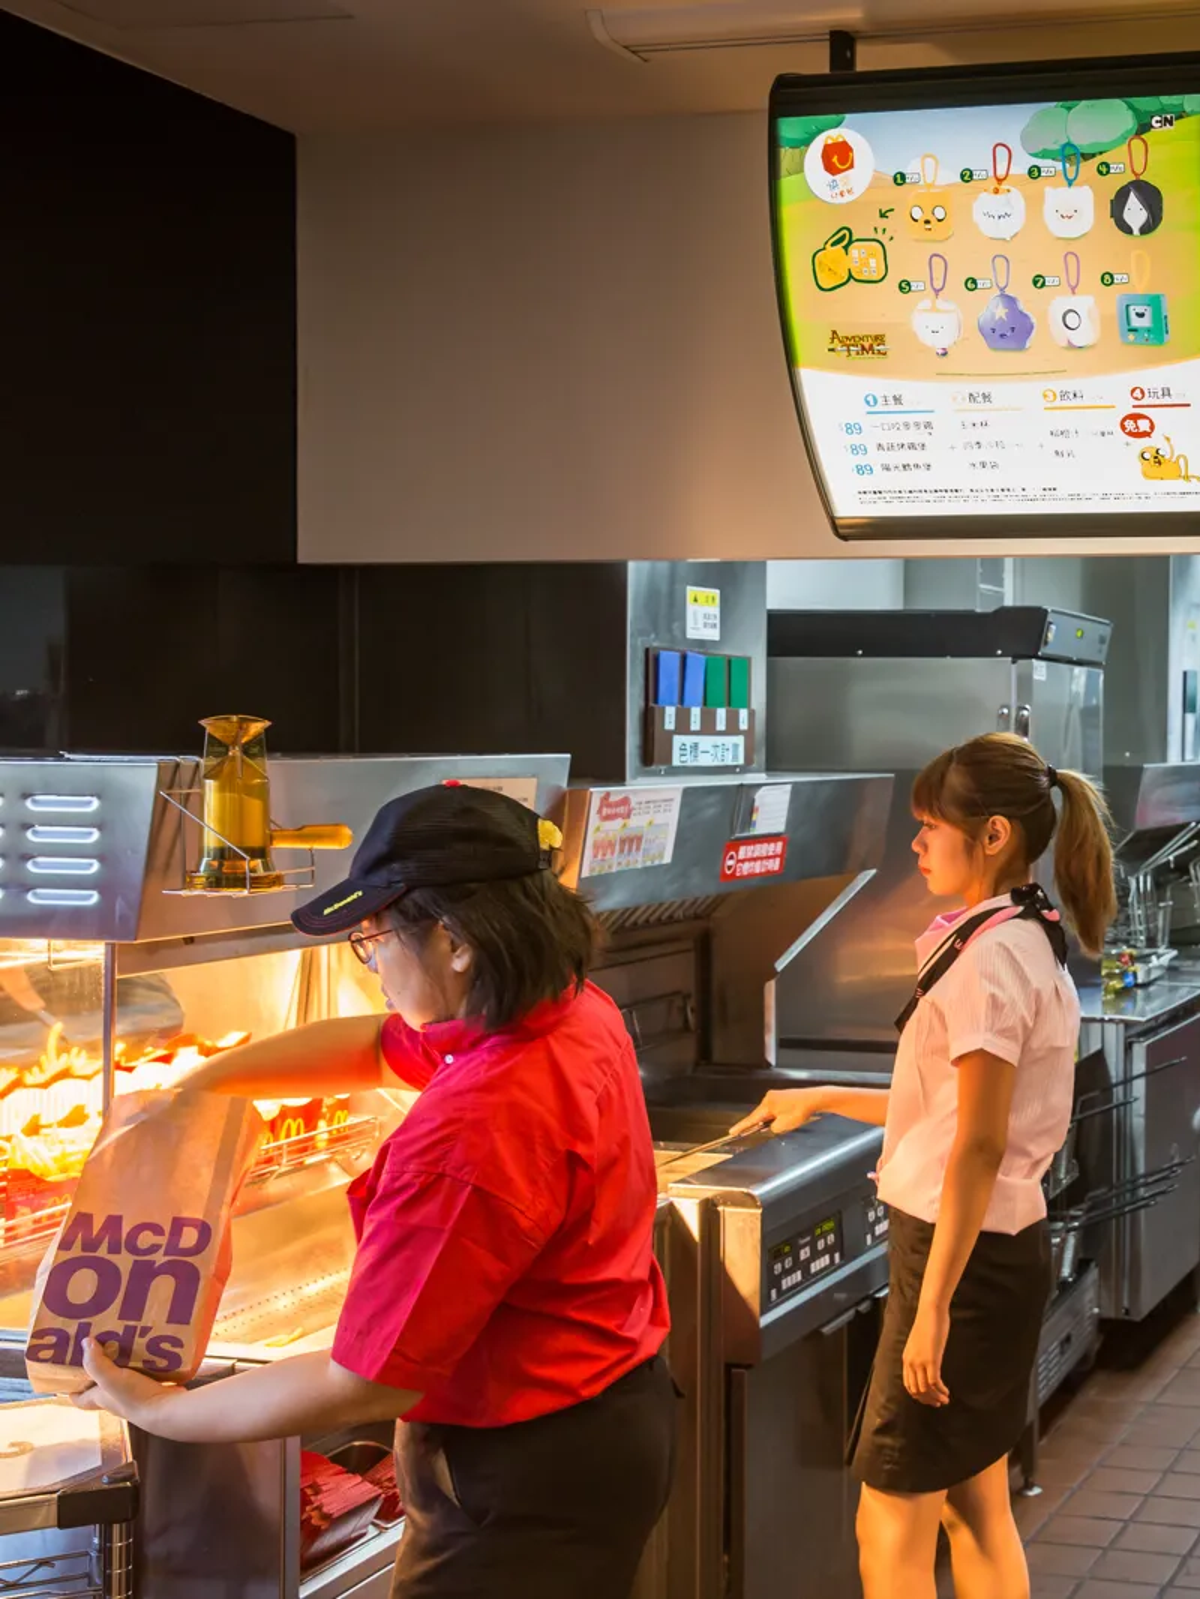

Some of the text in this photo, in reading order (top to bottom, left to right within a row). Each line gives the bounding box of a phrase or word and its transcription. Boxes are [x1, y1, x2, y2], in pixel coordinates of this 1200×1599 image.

[1150, 114, 1175, 130] CN
[1147, 387, 1173, 400] 玩具
[57, 1210, 213, 1258] McD
[41, 1254, 201, 1326] on
[24, 1321, 185, 1374] ald's
